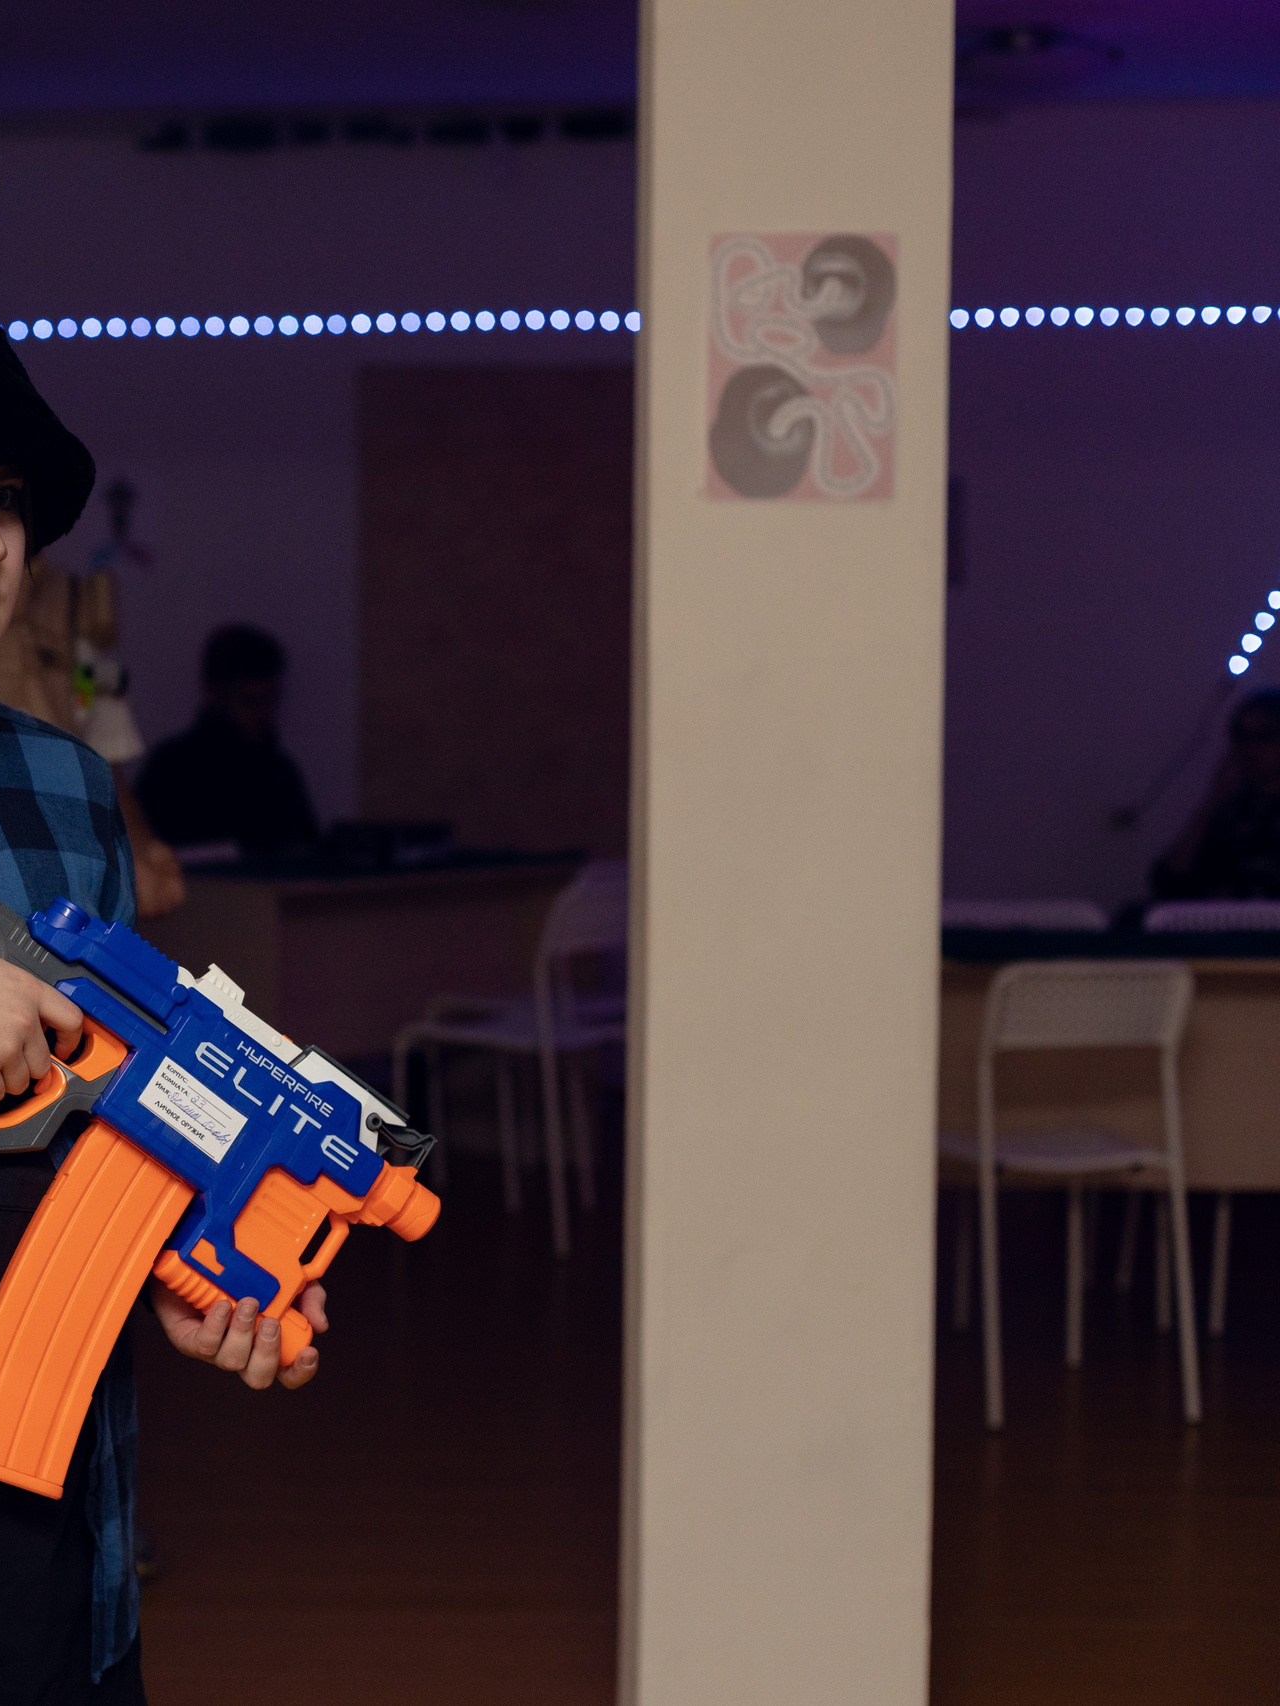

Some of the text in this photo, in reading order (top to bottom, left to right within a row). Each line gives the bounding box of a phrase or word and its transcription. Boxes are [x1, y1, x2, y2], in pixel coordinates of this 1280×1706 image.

[194, 1041, 359, 1171] ELITE
[236, 1040, 334, 1118] HYPERFIRE
[154, 1100, 206, 1141] ЛИЧНОЕ ОРУЖИЕ
